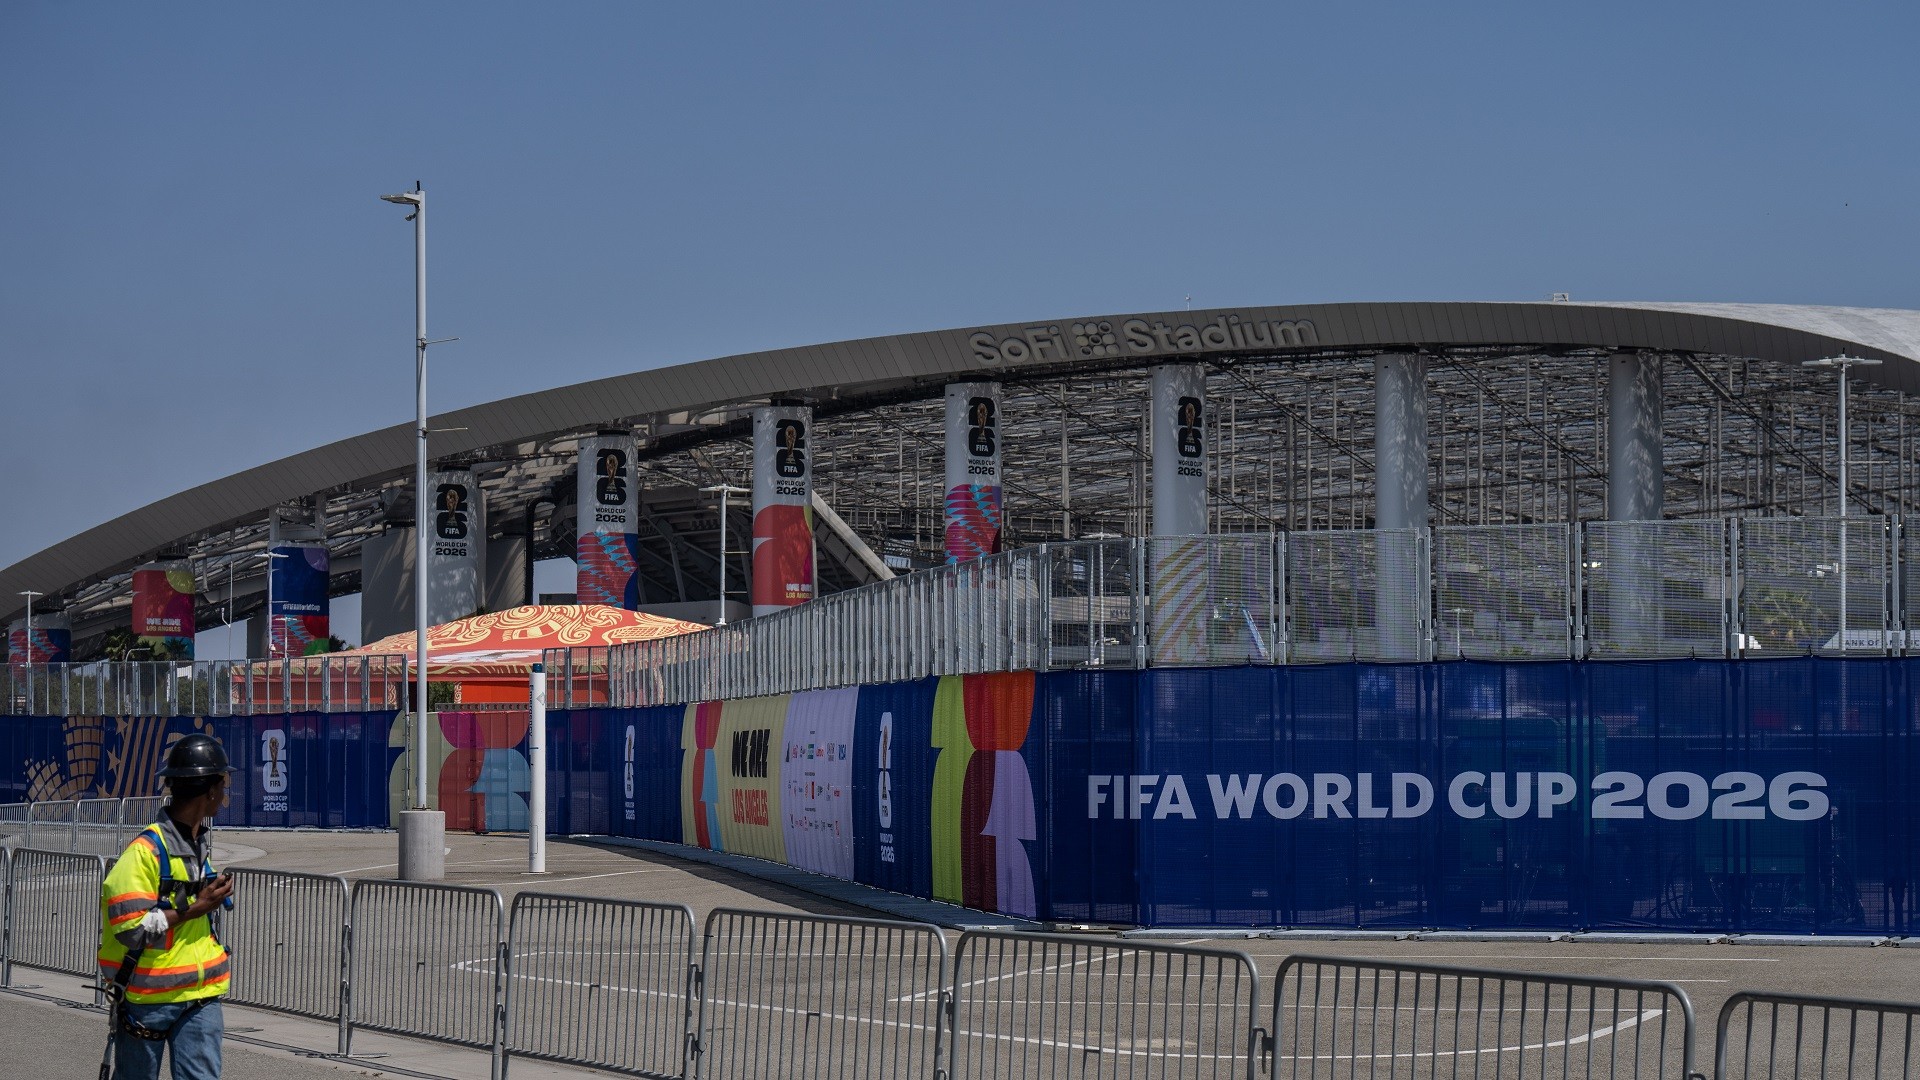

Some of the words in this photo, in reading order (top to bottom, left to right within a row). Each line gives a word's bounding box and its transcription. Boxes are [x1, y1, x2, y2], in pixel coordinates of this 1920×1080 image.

[969, 325, 1069, 366] SoFi
[1122, 314, 1320, 352] Stadium
[976, 444, 989, 452] FIFA
[1184, 444, 1197, 453] FIFA
[784, 465, 798, 473] FIFA
[968, 465, 995, 476] 2026
[1178, 467, 1203, 477] 2026
[776, 486, 806, 496] 2026
[604, 493, 619, 501] FIFA
[595, 513, 626, 523] 2026
[445, 527, 460, 535] FIFA
[435, 547, 467, 557] 2026
[732, 730, 750, 777] WE
[749, 729, 770, 778] ARE
[1088, 775, 1197, 819] FIFA
[1206, 773, 1435, 820] WORLD
[1448, 770, 1577, 819] CUP
[1591, 771, 1830, 821] 2026
[263, 801, 288, 812] 2026
[732, 788, 745, 824] LOS
[745, 788, 769, 827] ANGELES
